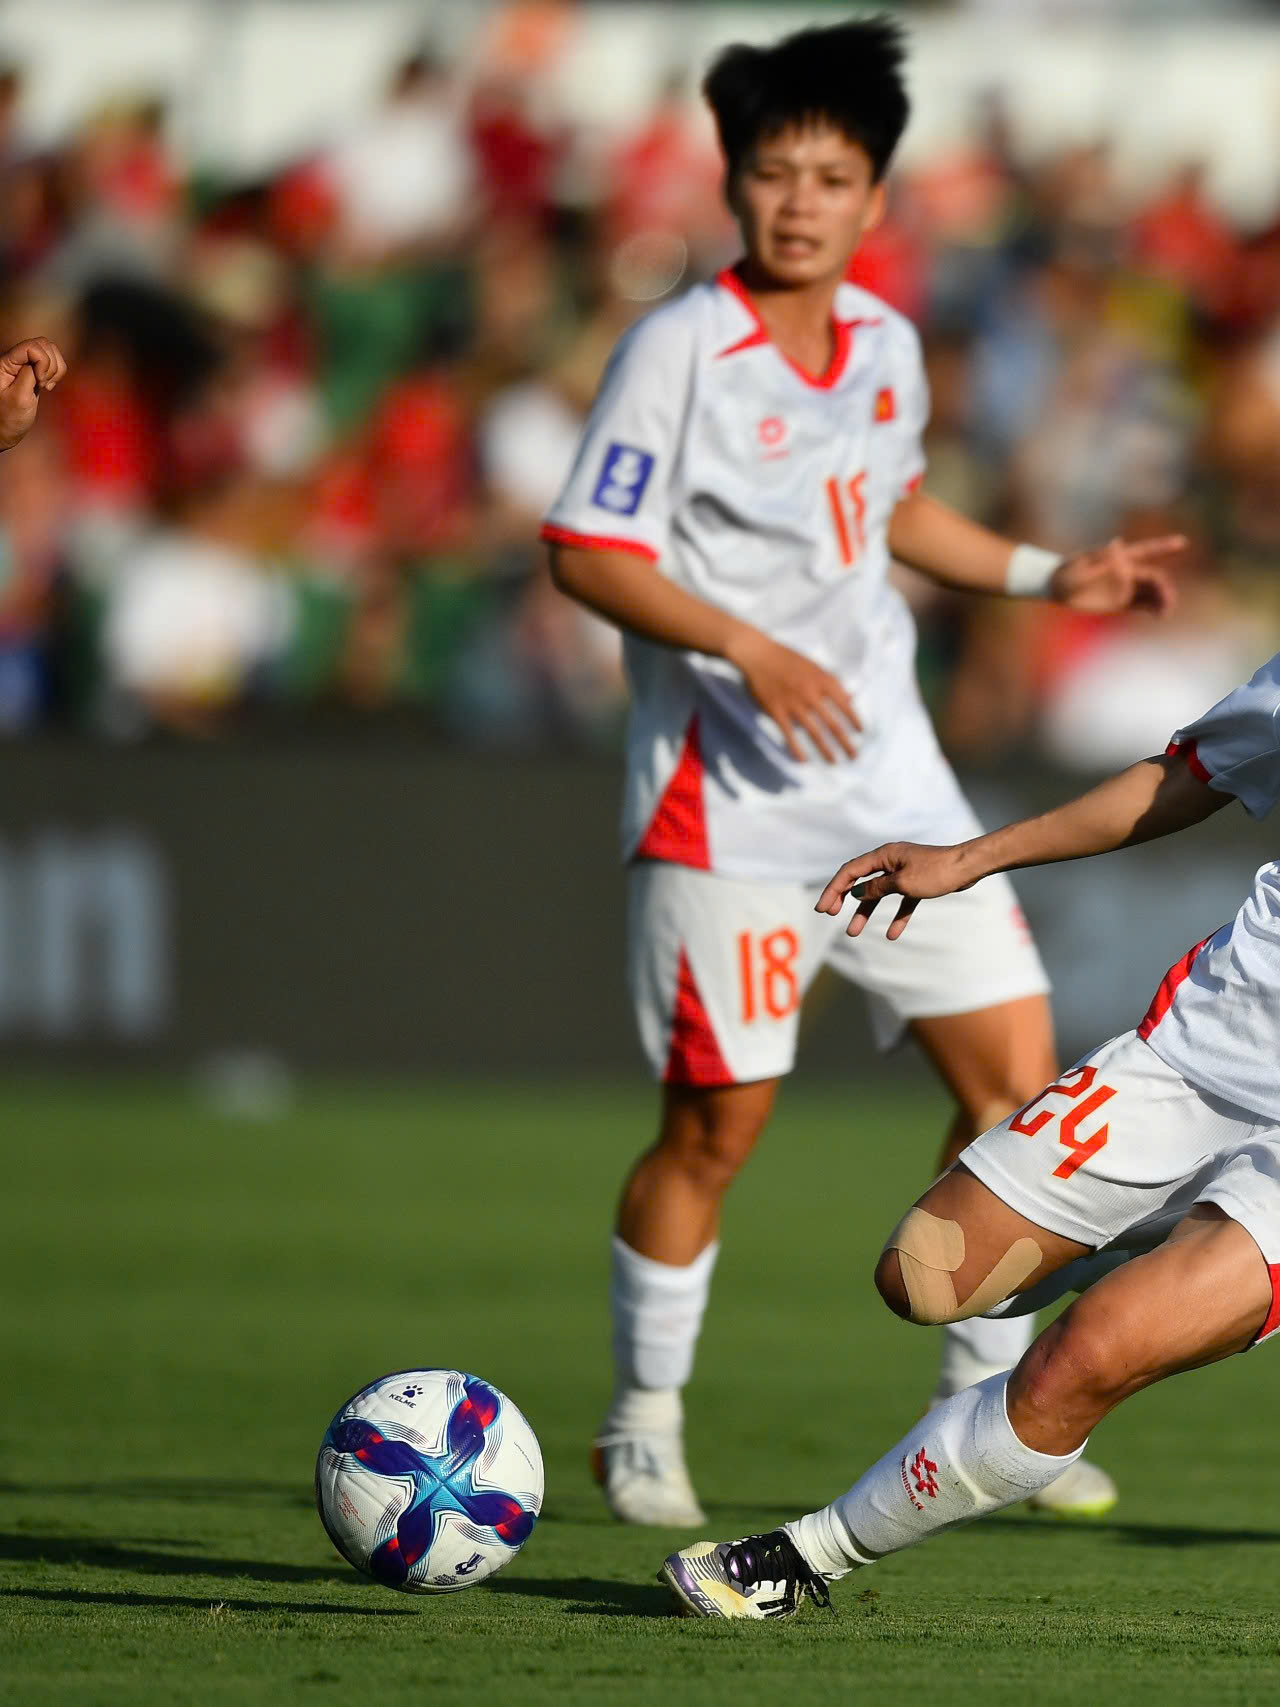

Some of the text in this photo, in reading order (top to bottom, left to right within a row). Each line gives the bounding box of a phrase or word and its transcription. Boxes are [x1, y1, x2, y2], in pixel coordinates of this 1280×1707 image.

[737, 927, 801, 1025] 18
[1008, 1065, 1118, 1180] 24
[388, 1393, 417, 1409] KELME
